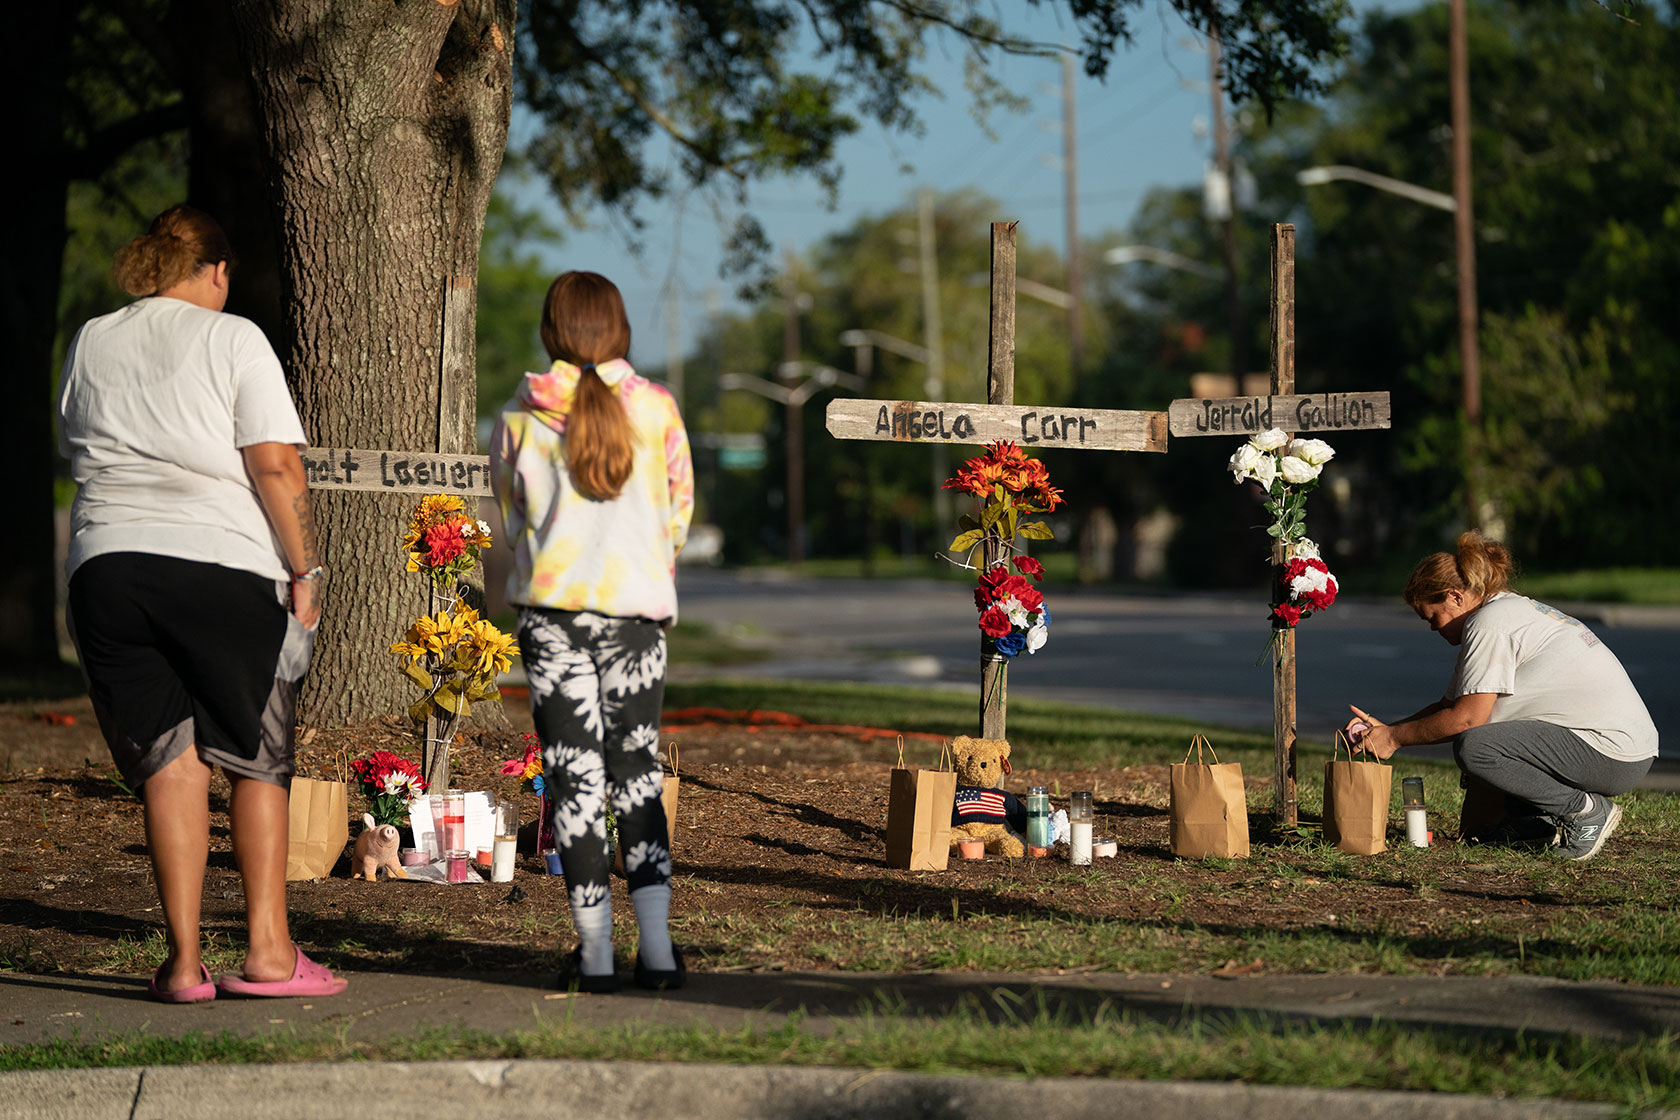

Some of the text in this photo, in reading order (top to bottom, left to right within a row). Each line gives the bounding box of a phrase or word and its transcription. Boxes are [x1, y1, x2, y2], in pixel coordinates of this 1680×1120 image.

[875, 405, 1097, 443] Angela Carr
[1196, 394, 1375, 432] Jerrald Gallion
